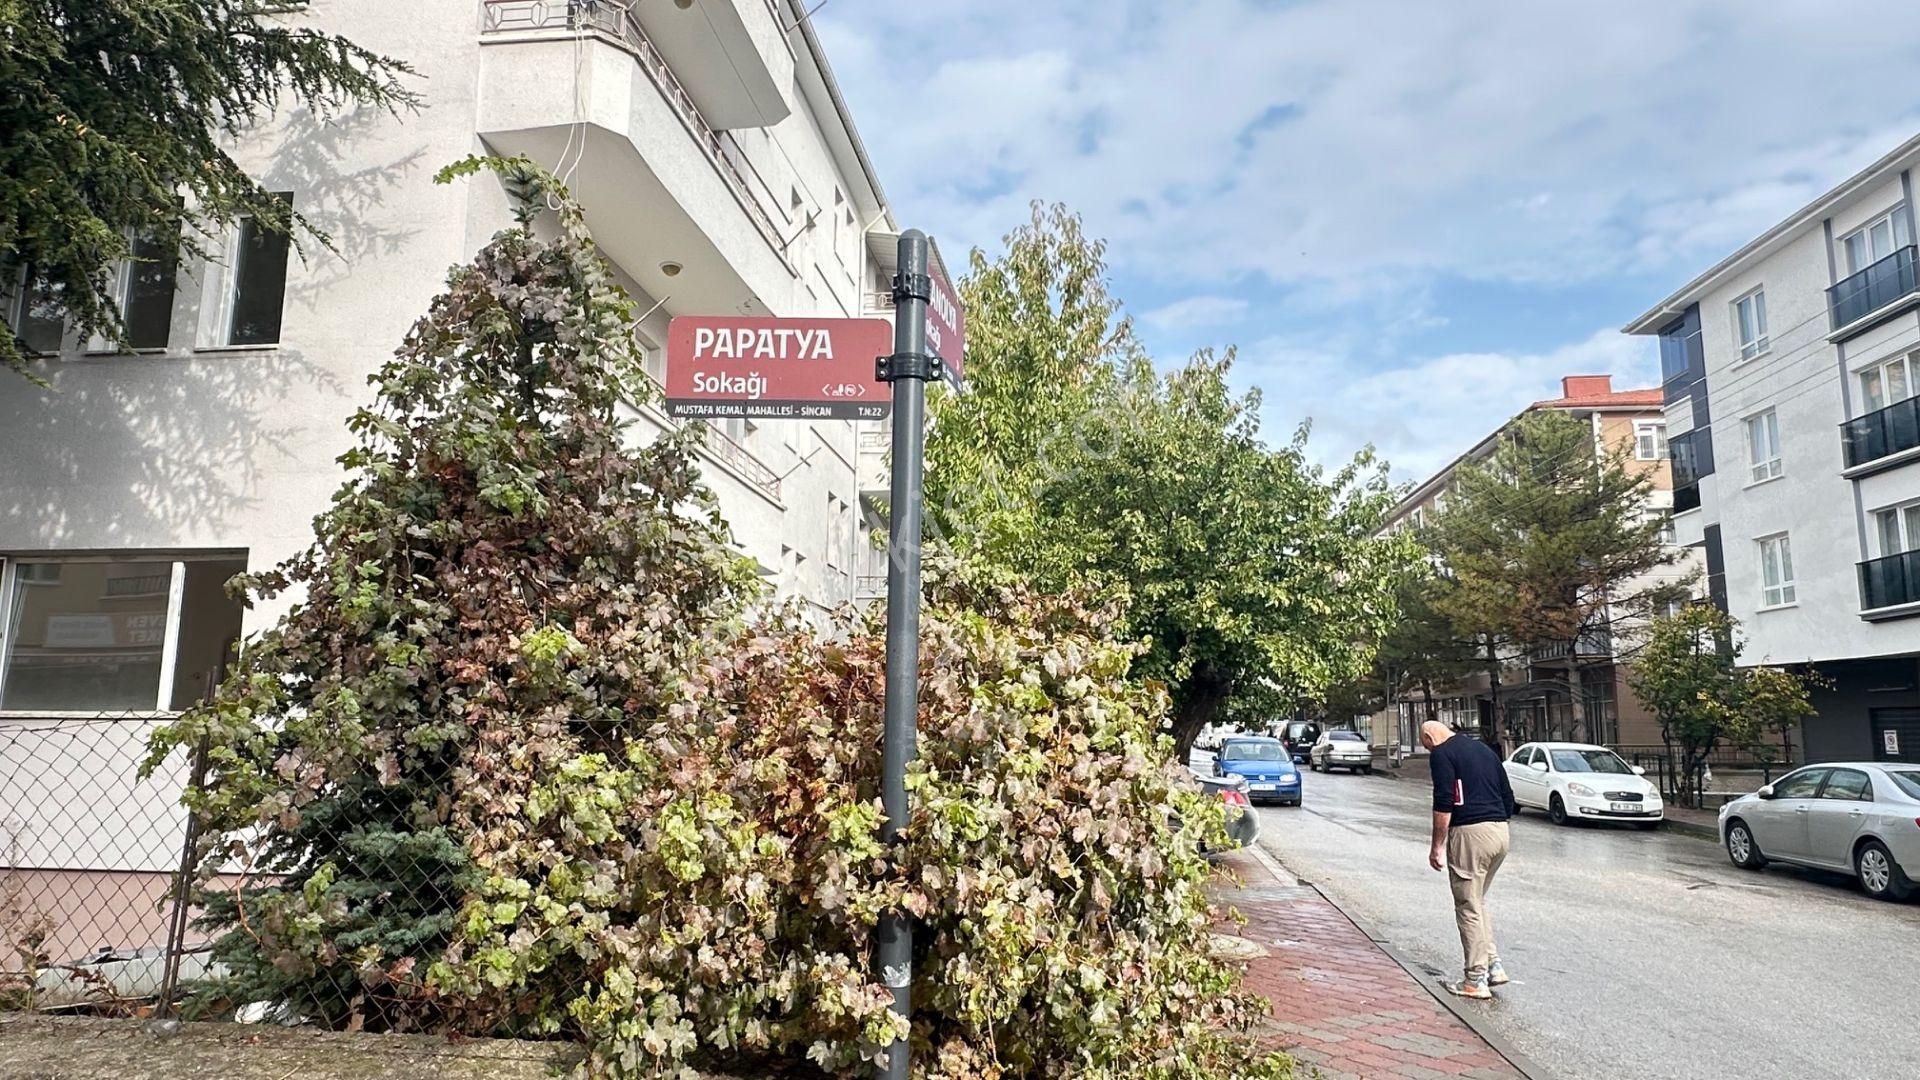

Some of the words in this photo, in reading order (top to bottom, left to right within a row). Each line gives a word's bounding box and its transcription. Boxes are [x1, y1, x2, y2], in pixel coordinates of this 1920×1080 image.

[930, 277, 957, 337] ANOLYA
[694, 327, 834, 360] PAPATYA
[692, 371, 768, 400] Sokağı
[674, 405, 714, 416] MUSTAFA
[715, 405, 744, 416] KEMAL
[746, 405, 794, 416] MAHALLESİ
[801, 405, 832, 417] SİNCAN
